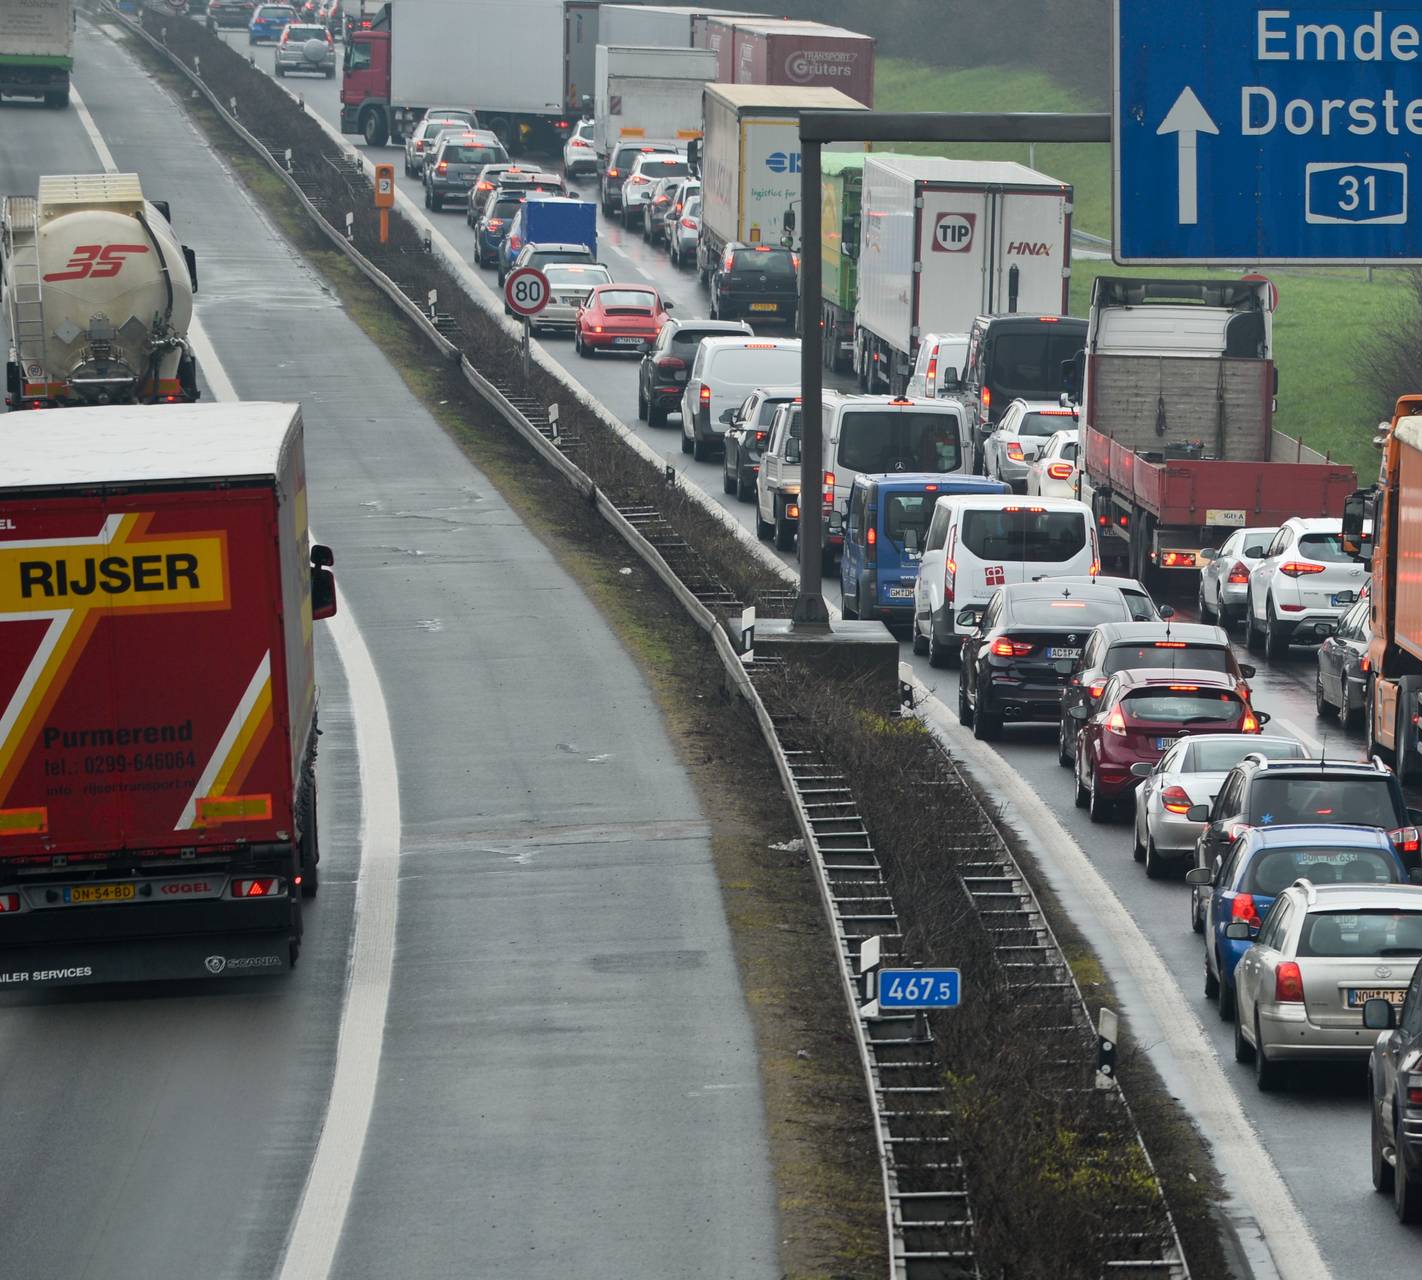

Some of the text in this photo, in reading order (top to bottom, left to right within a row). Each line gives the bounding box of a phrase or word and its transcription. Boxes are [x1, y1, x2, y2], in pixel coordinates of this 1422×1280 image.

[1337, 175, 1376, 212] 31
[939, 224, 970, 243] TIP
[1007, 242, 1052, 256] HNA
[516, 281, 540, 301] 80
[19, 553, 200, 598] RIJSER
[43, 720, 193, 748] Purmerend
[84, 752, 196, 775] 0299-646064
[227, 955, 282, 969] SCANIA
[33, 966, 92, 981] SERVICES
[888, 978, 951, 1000] 467.5
